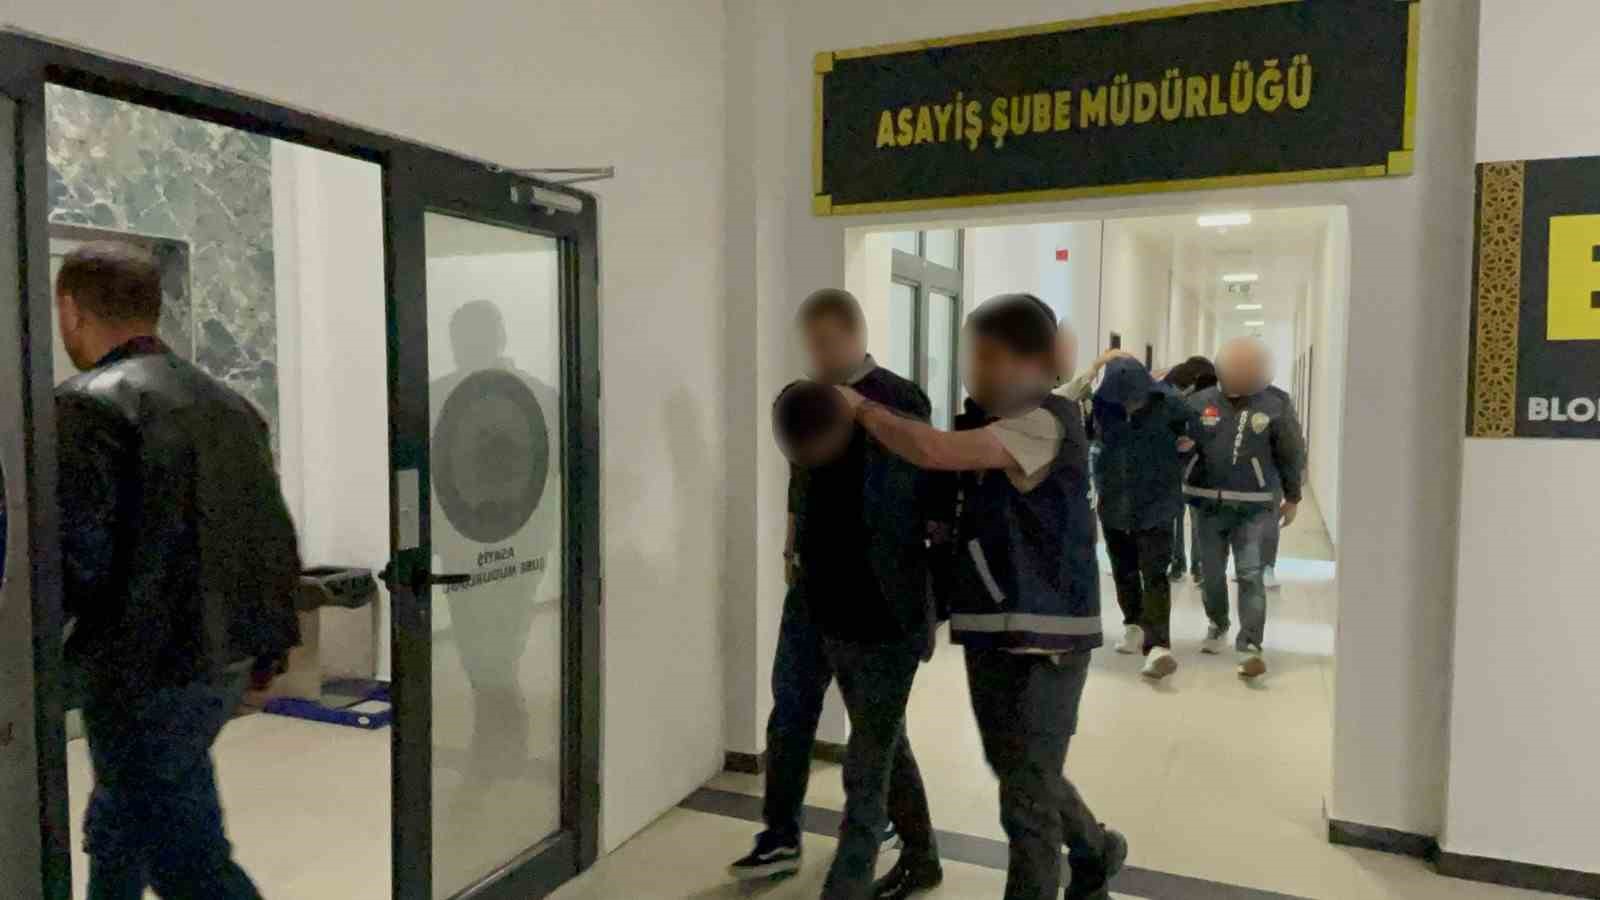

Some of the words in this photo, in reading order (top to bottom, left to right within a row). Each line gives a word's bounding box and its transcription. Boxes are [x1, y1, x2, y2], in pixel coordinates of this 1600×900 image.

[876, 91, 983, 151] ASAYİŞ
[991, 91, 1071, 149] ŞUBE
[1080, 53, 1312, 128] MÜDÜRLÜĞÜ
[1528, 396, 1600, 421] BLO
